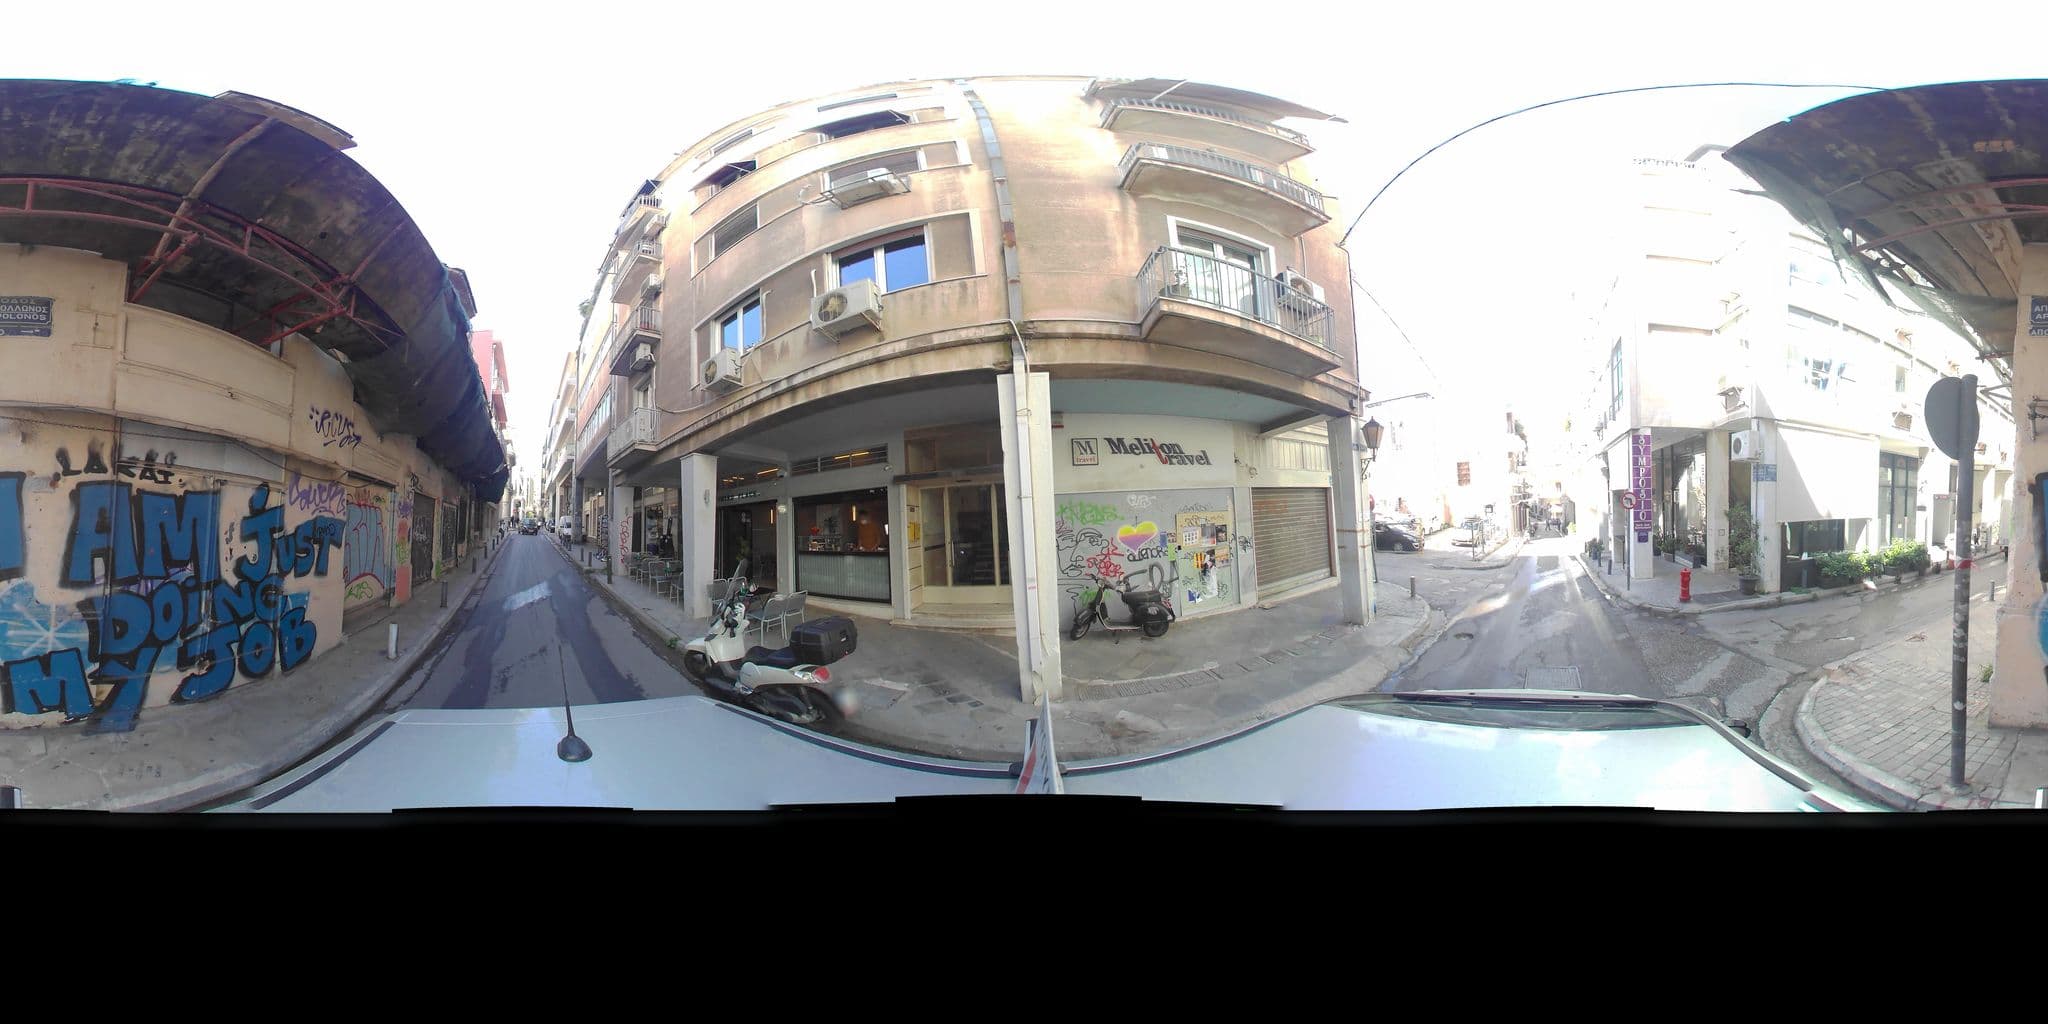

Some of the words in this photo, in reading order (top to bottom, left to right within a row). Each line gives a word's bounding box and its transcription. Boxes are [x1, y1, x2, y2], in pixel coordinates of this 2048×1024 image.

[0, 313, 47, 321] OLONOS
[1074, 440, 1096, 455] M
[1075, 456, 1097, 464] travel
[1638, 435, 1647, 521] SYMPOSIO
[58, 480, 222, 588] AM
[1, 643, 165, 735] MY
[171, 606, 318, 704] JOB
